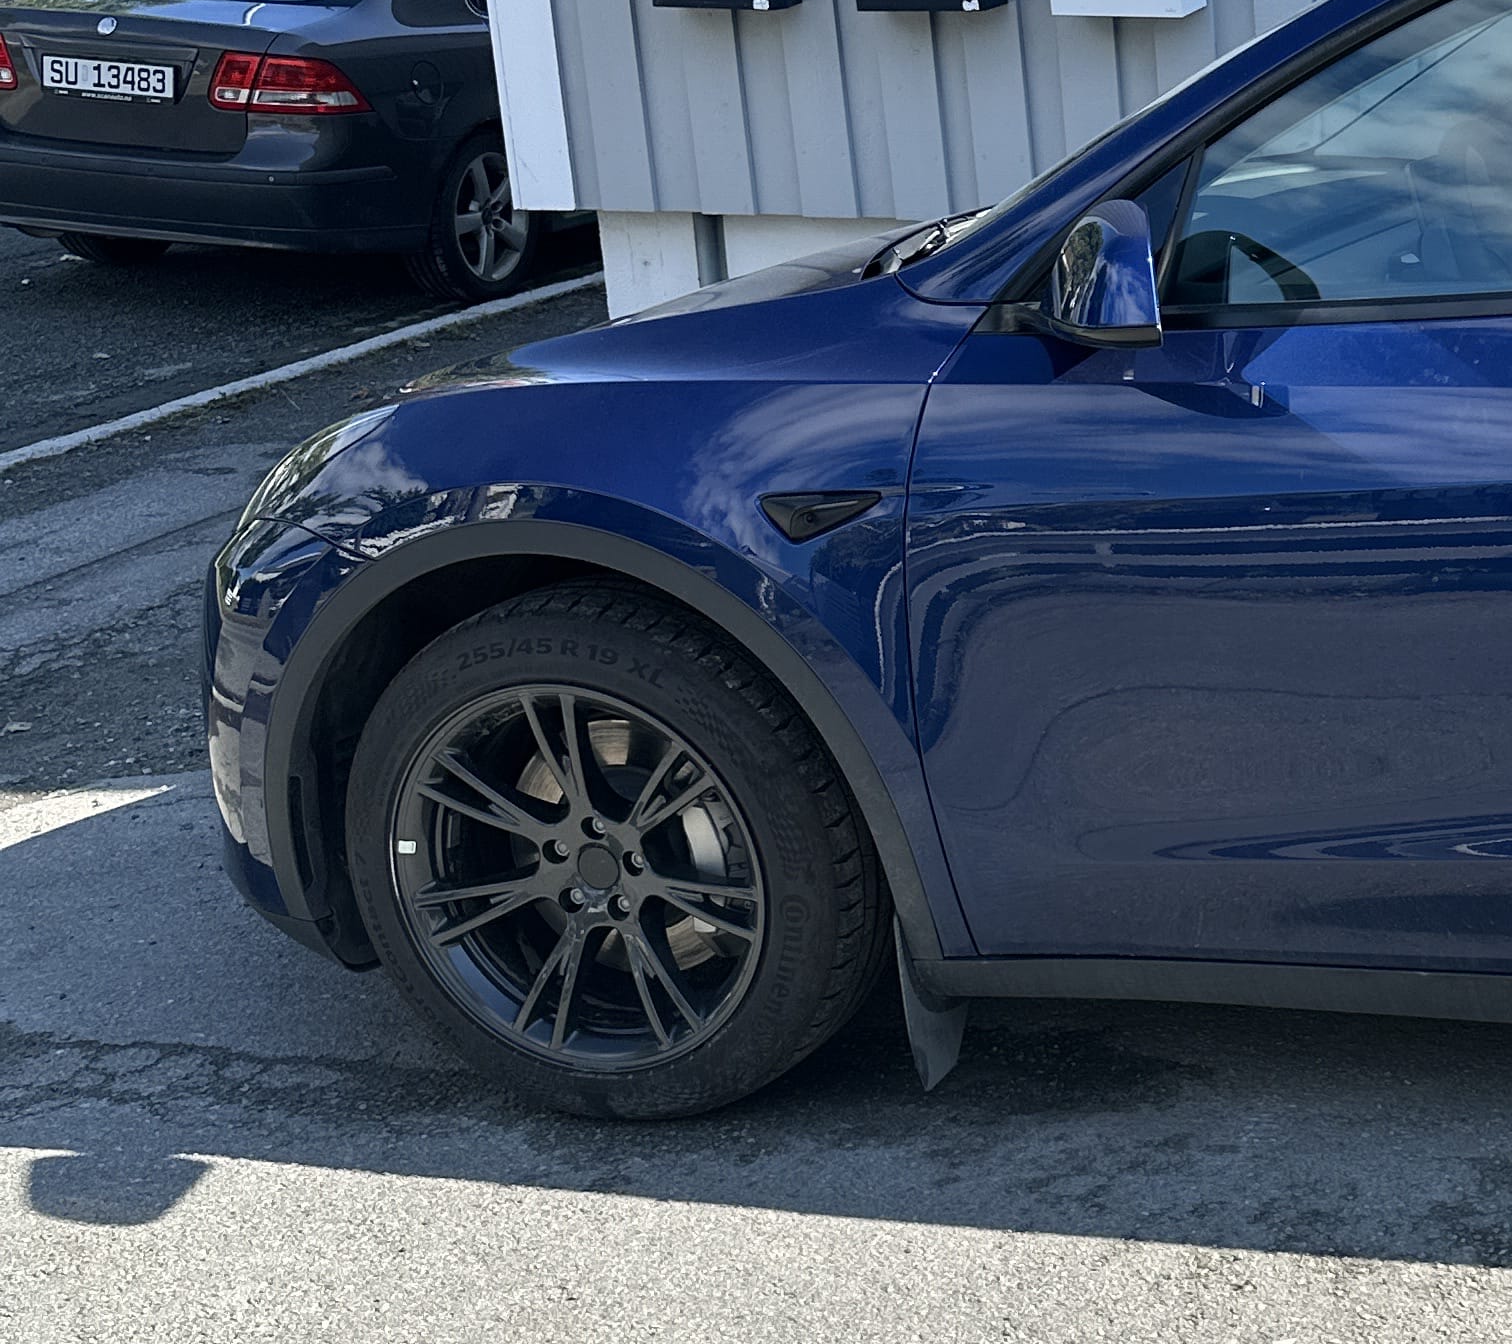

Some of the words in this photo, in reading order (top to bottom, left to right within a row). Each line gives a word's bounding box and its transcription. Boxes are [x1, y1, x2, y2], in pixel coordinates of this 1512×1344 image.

[50, 59, 78, 85] SU
[92, 63, 166, 94] 13483
[456, 637, 553, 672] 255/45
[559, 638, 579, 657] R
[587, 643, 620, 666] 19
[625, 655, 665, 690] XL
